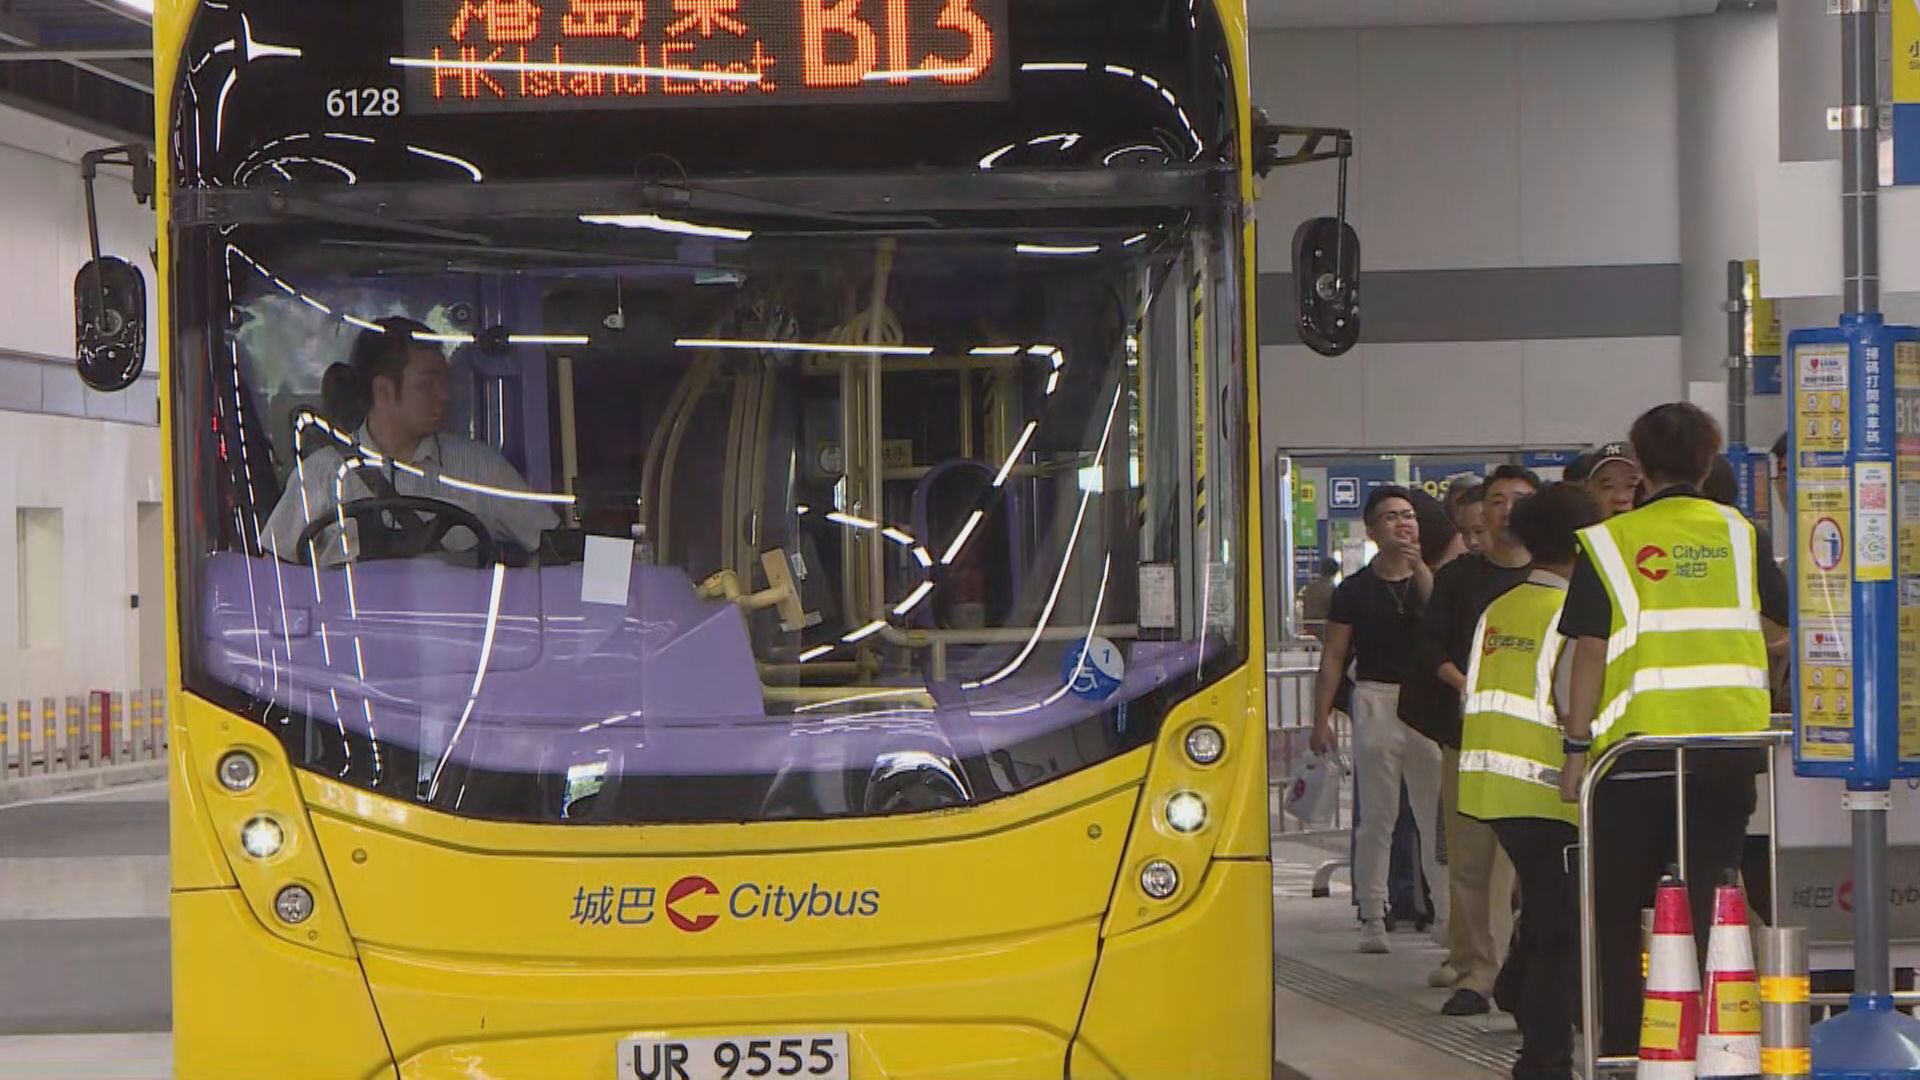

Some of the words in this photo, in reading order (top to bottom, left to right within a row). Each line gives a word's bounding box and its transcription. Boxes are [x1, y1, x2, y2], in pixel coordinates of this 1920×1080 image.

[802, 0, 993, 87] B13
[432, 46, 505, 98] HK
[519, 42, 648, 96] Island
[661, 40, 776, 93] East
[326, 88, 400, 116] 6128
[1672, 544, 1729, 560] Citybus
[570, 886, 656, 925] 城巴
[729, 883, 880, 922] Citybus
[633, 1043, 690, 1080] UR
[714, 1038, 834, 1079] 9555
